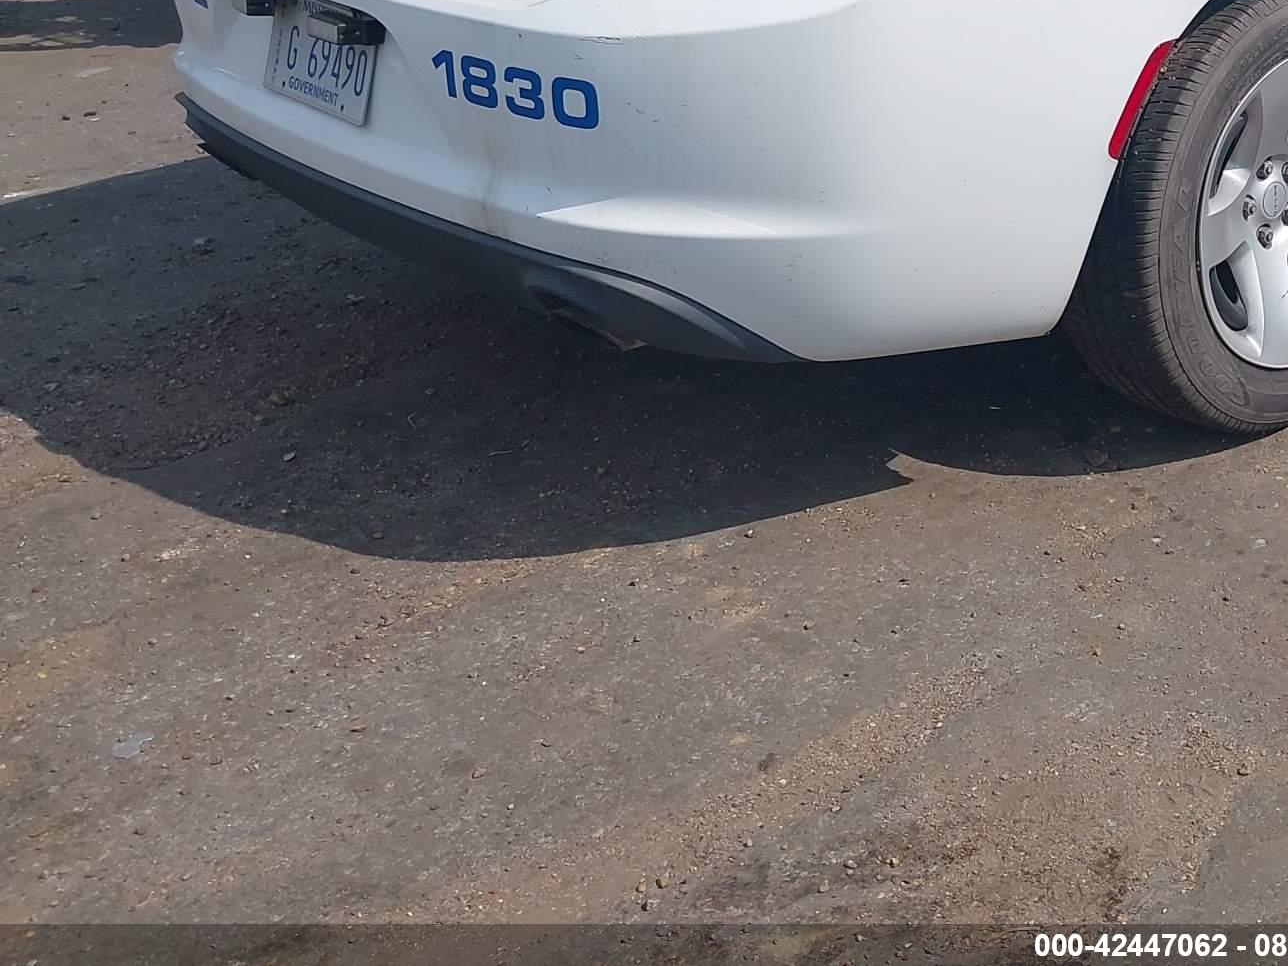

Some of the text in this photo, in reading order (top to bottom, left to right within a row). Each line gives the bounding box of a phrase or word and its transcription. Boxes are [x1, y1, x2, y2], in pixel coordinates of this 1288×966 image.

[286, 25, 300, 70] G
[307, 36, 368, 96] 69490
[288, 75, 339, 107] GOVERNMENT
[431, 49, 600, 130] 1830
